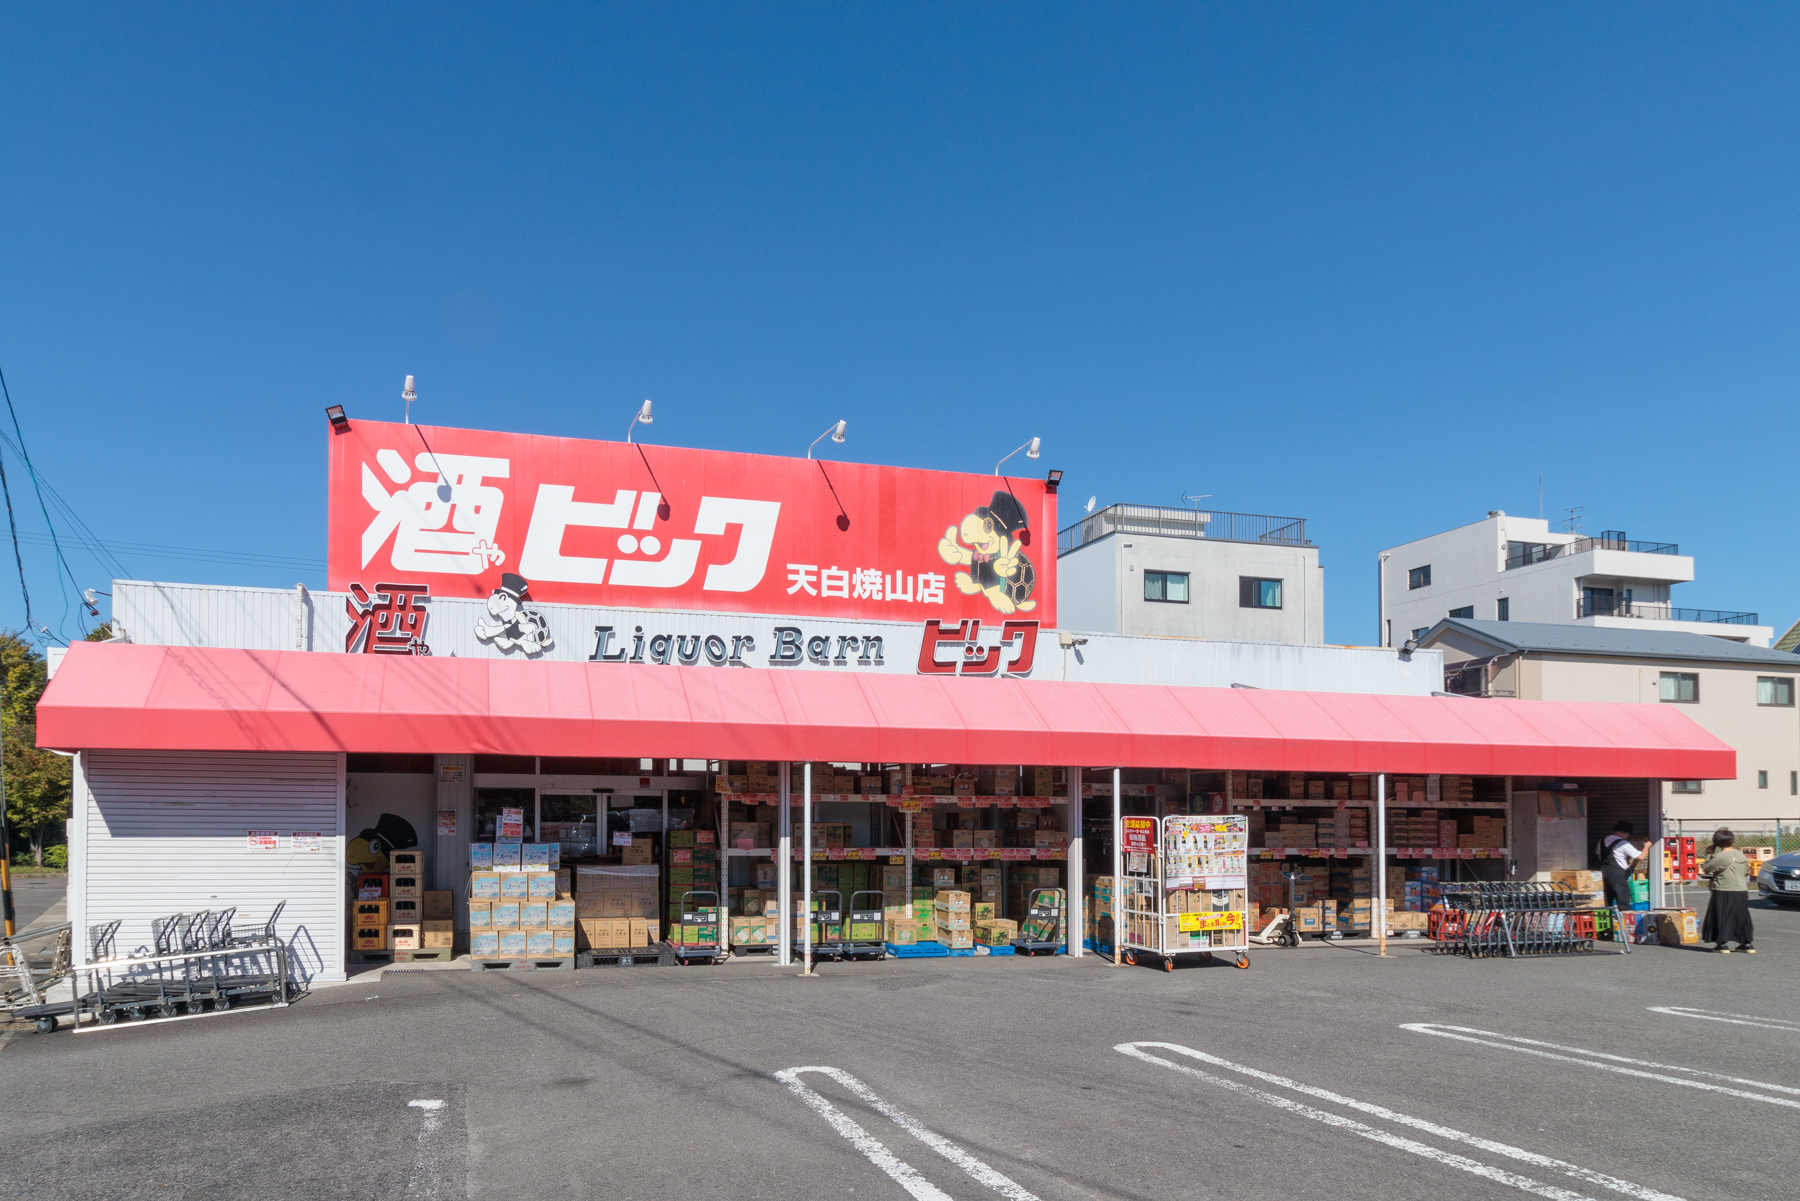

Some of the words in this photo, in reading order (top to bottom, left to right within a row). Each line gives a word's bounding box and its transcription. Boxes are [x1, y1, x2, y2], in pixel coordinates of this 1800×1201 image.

[786, 563, 945, 604] 天白焼山店
[588, 625, 755, 665] Liquor
[768, 626, 885, 665] Barn
[917, 619, 1041, 675] ビック
